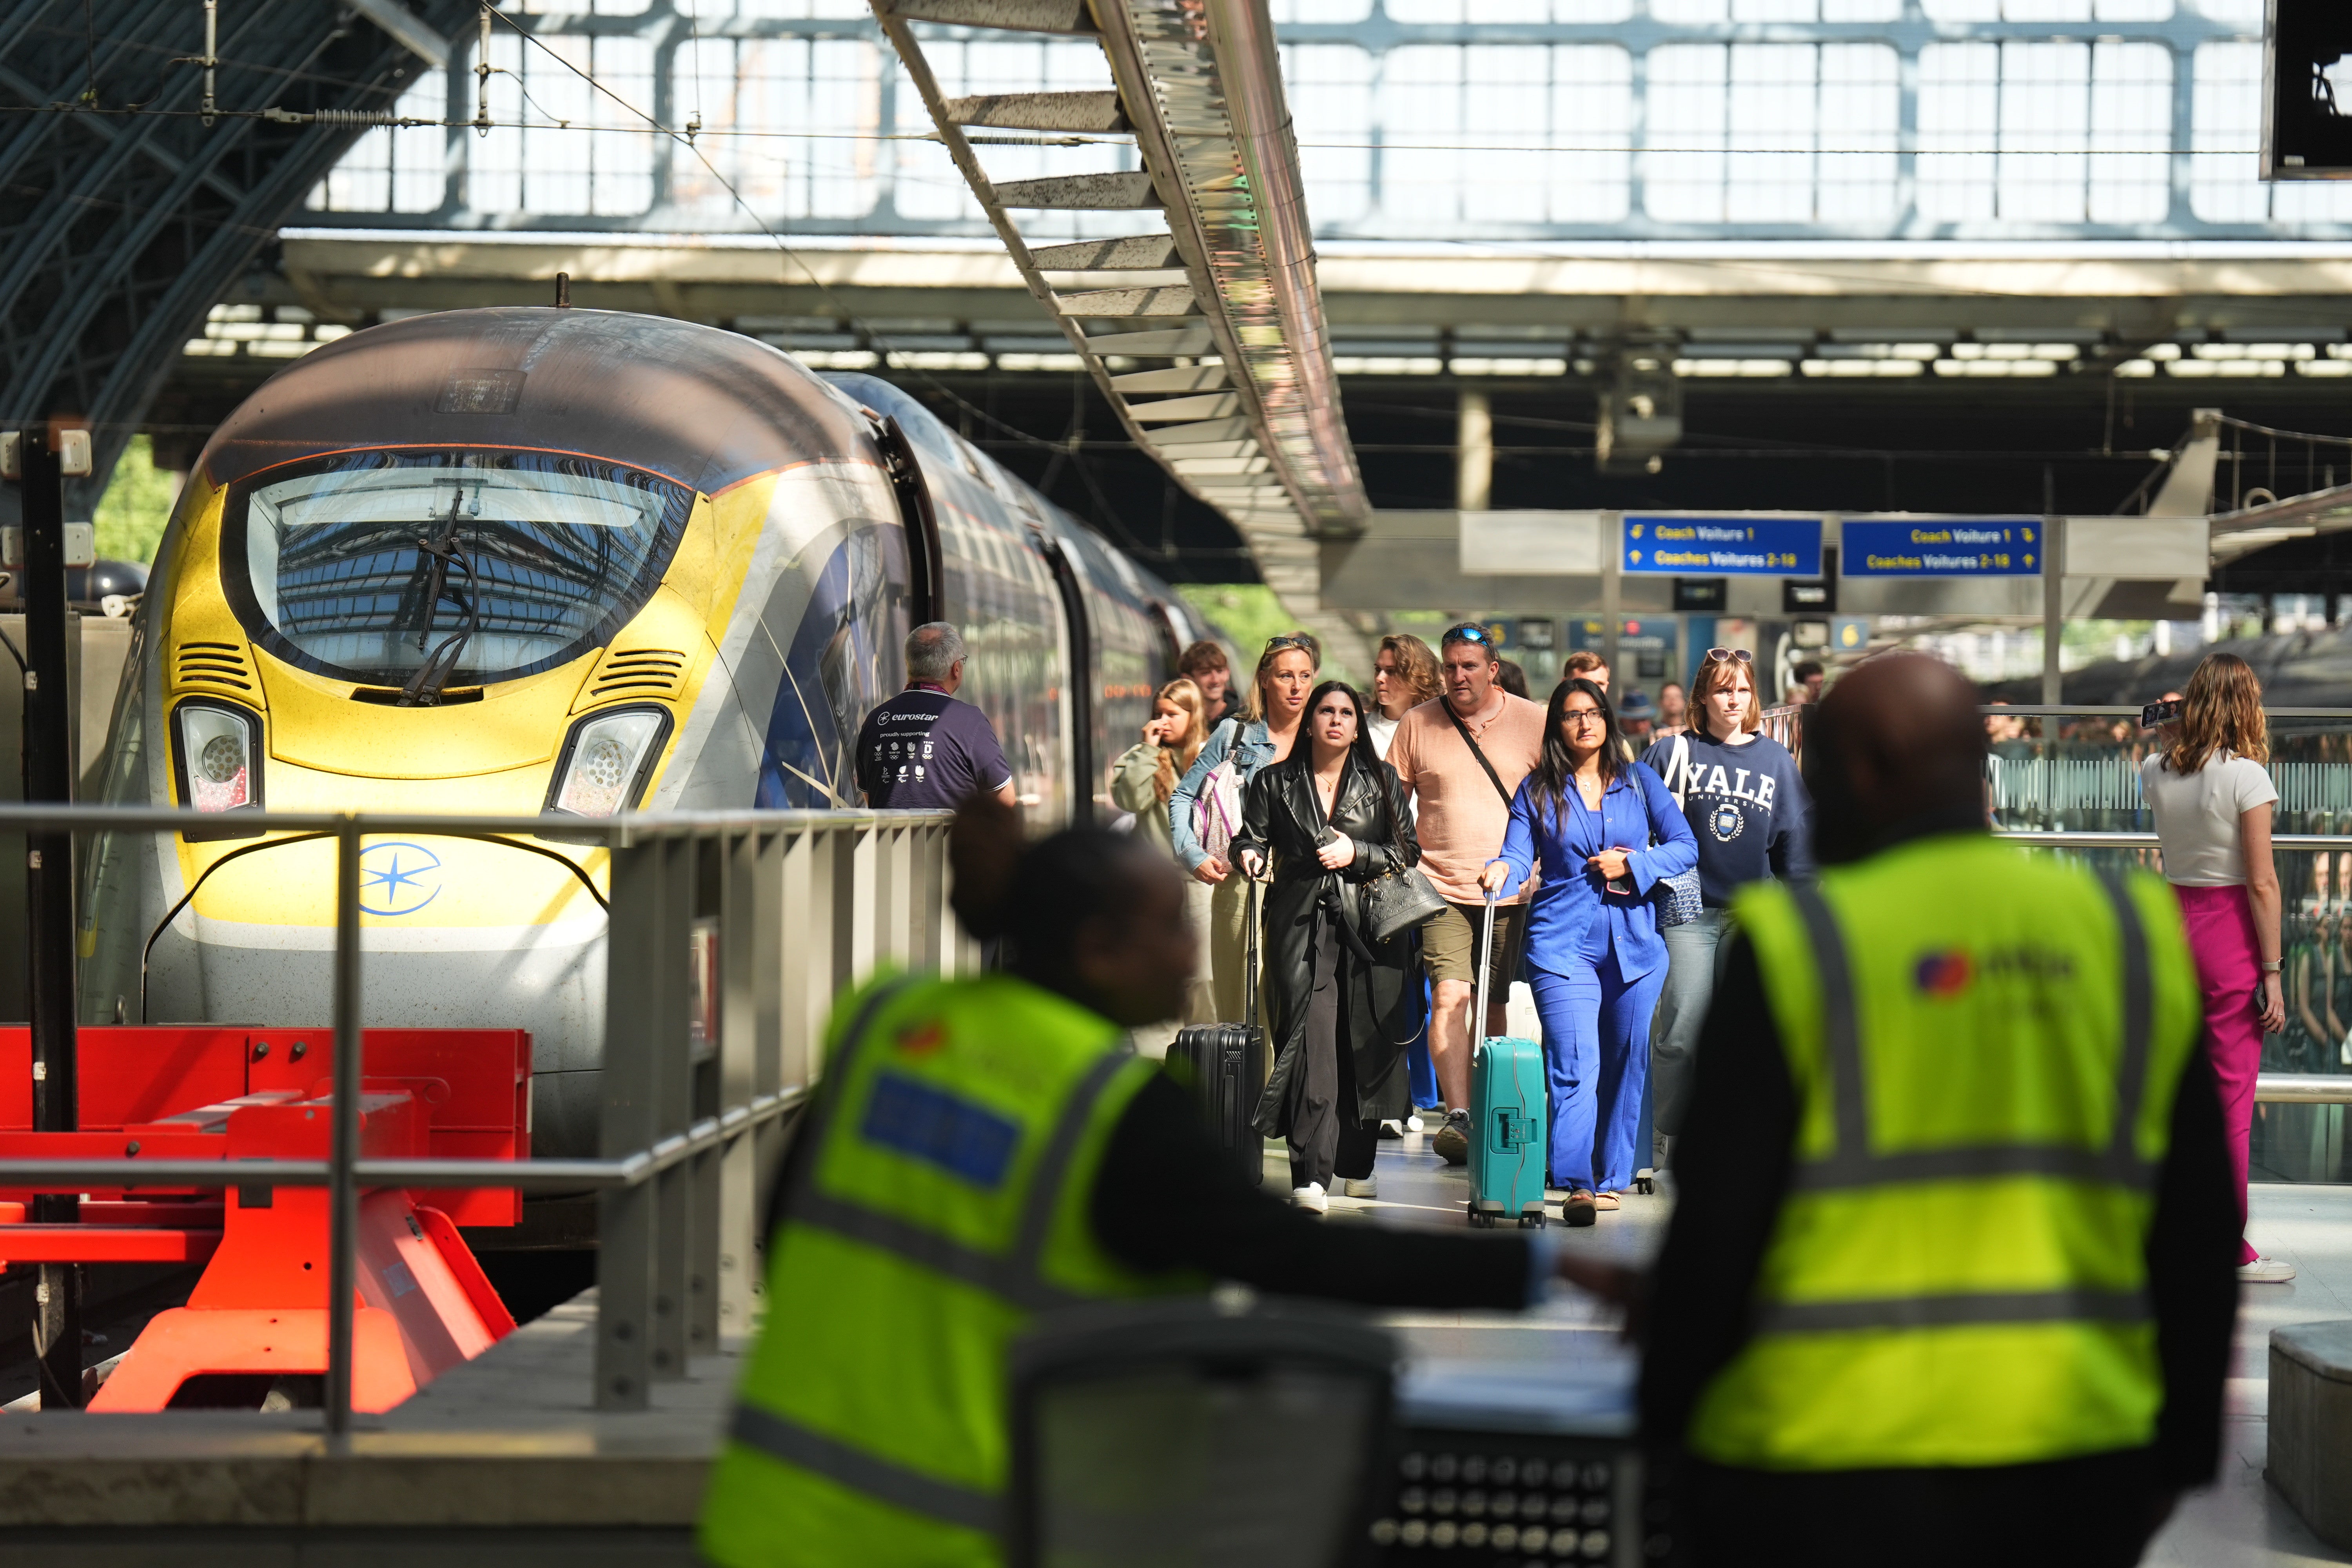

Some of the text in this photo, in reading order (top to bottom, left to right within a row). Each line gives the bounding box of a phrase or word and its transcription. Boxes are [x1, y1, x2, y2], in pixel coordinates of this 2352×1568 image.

[1655, 525, 1754, 541] Coach Voiture 1
[1911, 529, 2011, 544] Coach Voiture 1
[1654, 550, 1797, 567] Coaches Voitures 2-18
[1867, 554, 2010, 569] Coaches Voitures 2-18
[1842, 624, 1859, 647] 6
[924, 744, 932, 754] D
[1688, 762, 1775, 811] YALE
[1689, 794, 1770, 817] UNIVERSITY
